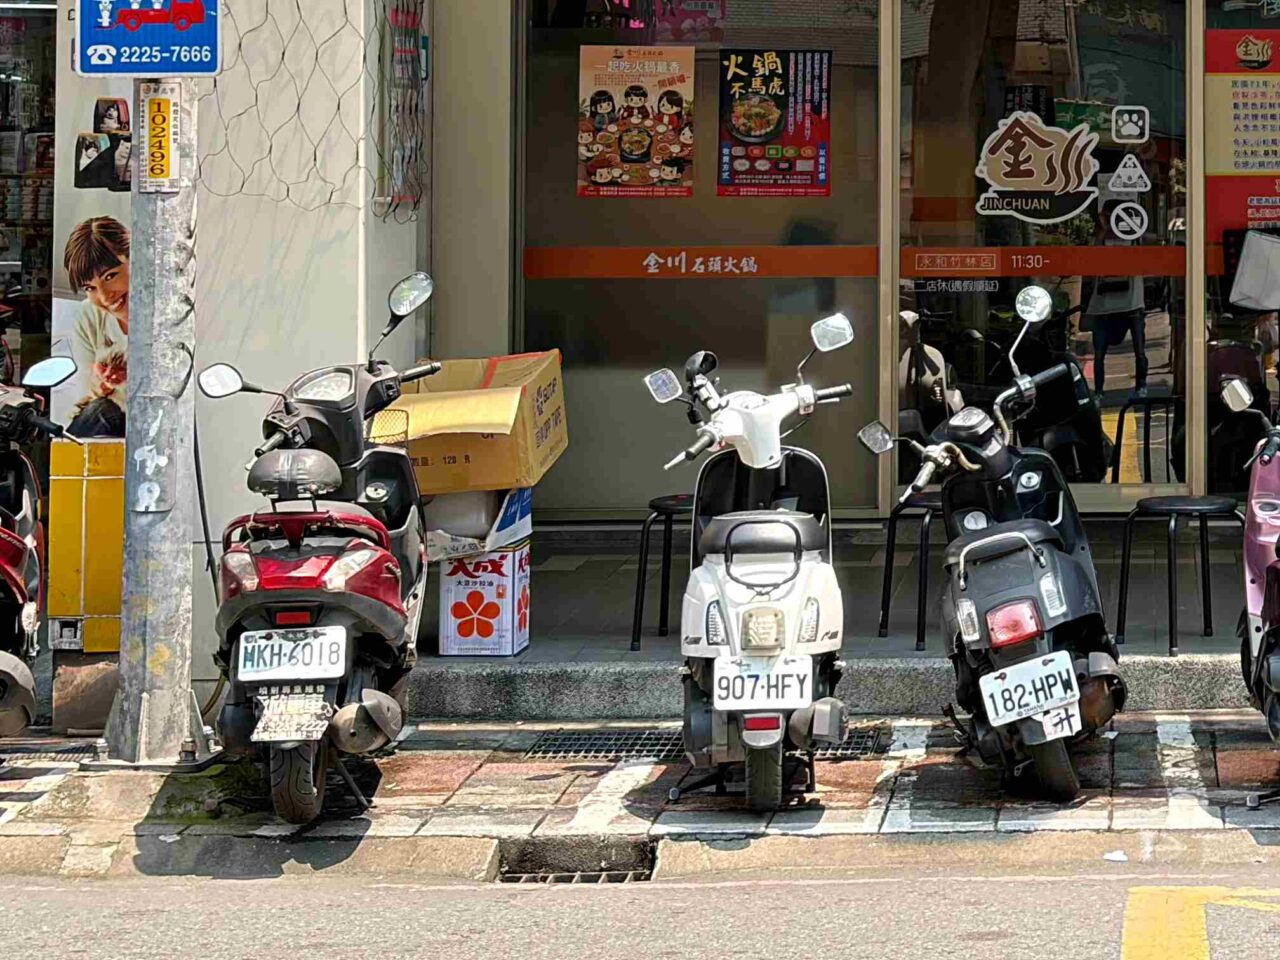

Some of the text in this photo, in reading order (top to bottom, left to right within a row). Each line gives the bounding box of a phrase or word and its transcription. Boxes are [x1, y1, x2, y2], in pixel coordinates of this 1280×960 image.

[120, 45, 211, 63] 2225-7666
[722, 51, 783, 81] 火鍋
[730, 76, 785, 100] 不馬虎
[150, 101, 167, 176] 102496
[981, 197, 1050, 210] JINCHUAN
[642, 251, 758, 274] 金川石頭火鍋
